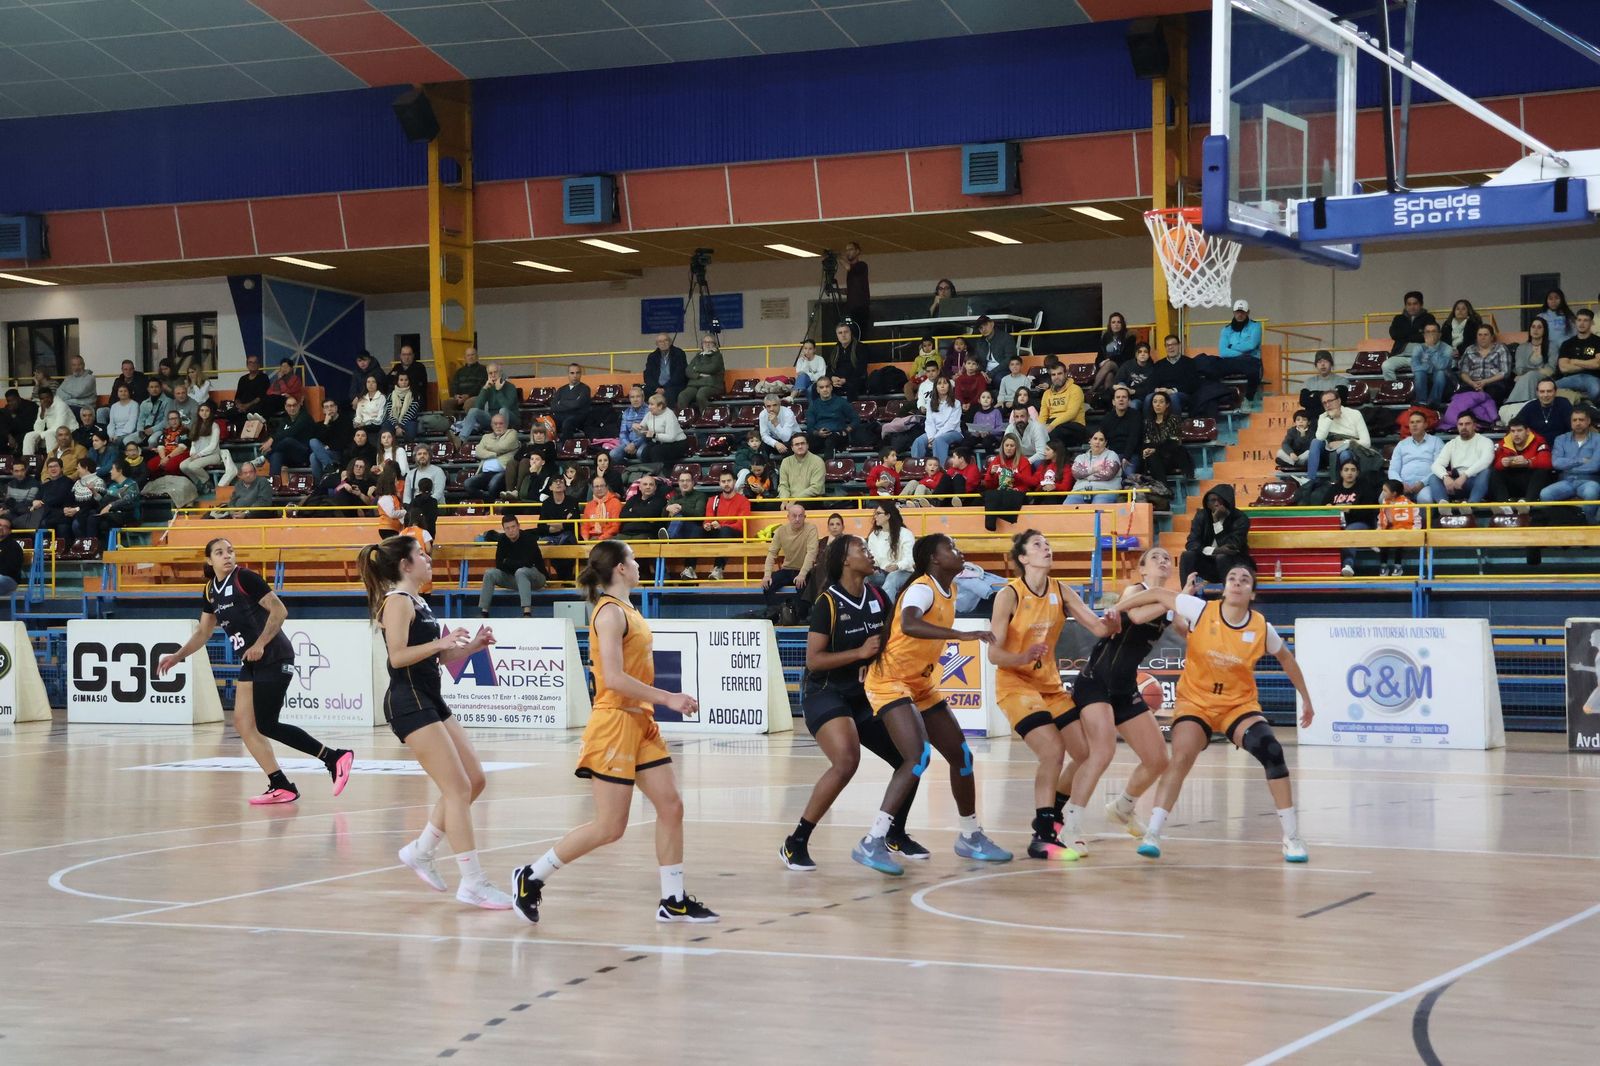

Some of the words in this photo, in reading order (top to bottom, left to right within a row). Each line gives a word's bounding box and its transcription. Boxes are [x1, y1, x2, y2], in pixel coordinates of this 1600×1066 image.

[1393, 193, 1481, 212] Schelde
[1393, 208, 1481, 229] Sports
[1242, 450, 1274, 461] FILA
[229, 631, 245, 651] 25
[709, 631, 729, 647] LUIS
[732, 631, 761, 647] FELIPE
[73, 642, 186, 702] G3C
[1346, 663, 1433, 699] C&M
[721, 676, 762, 692] FERRERO
[1212, 682, 1224, 695] 11
[72, 694, 108, 703] GIMNASIO
[150, 695, 186, 704] CRUCES
[284, 691, 320, 709] letas
[324, 693, 363, 710] salud
[463, 714, 474, 722] 05
[475, 714, 485, 722] 85
[486, 714, 497, 722] 90
[504, 715, 520, 723] 605
[521, 715, 532, 723] 76
[533, 715, 543, 723] 71
[545, 715, 556, 723] 05
[708, 708, 763, 726] ABOGADO
